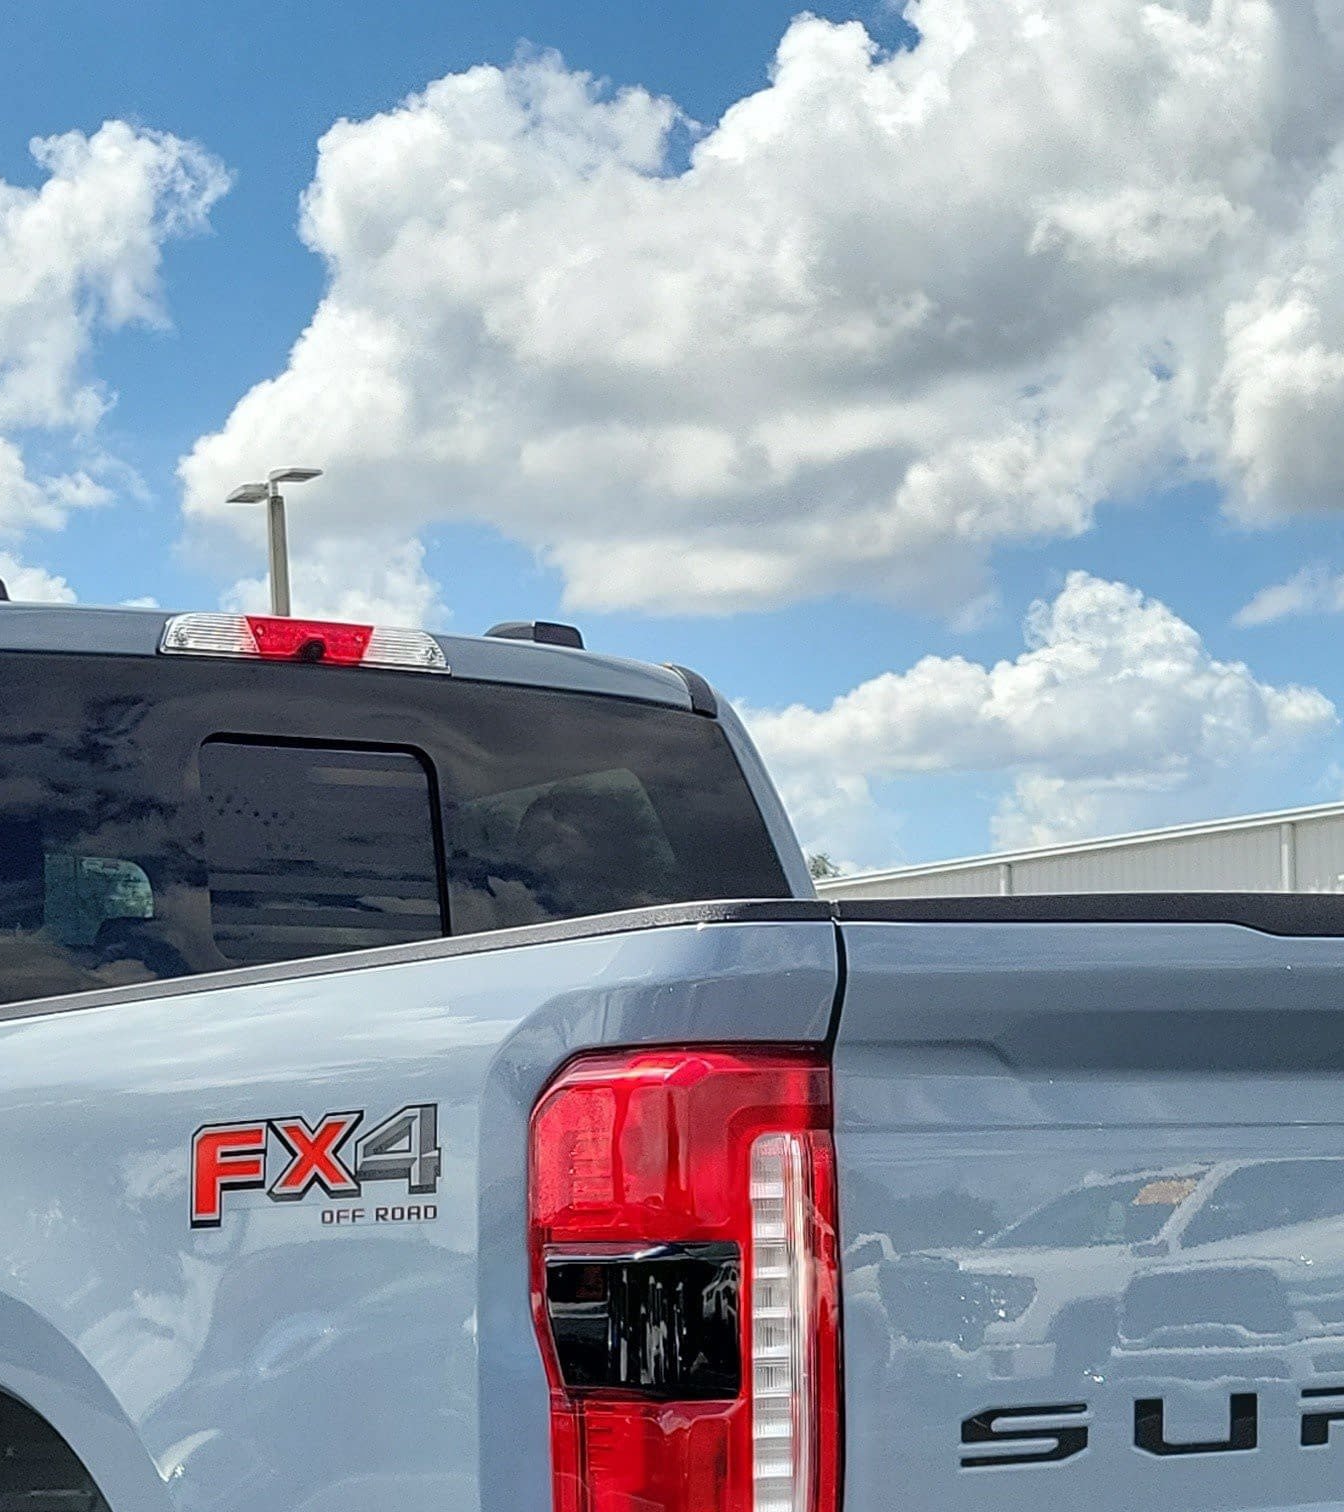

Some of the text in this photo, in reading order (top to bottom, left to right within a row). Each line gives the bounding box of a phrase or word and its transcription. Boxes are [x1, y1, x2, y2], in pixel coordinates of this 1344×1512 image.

[190, 1103, 441, 1228] FX4
[321, 1204, 438, 1225] OFF ROAD
